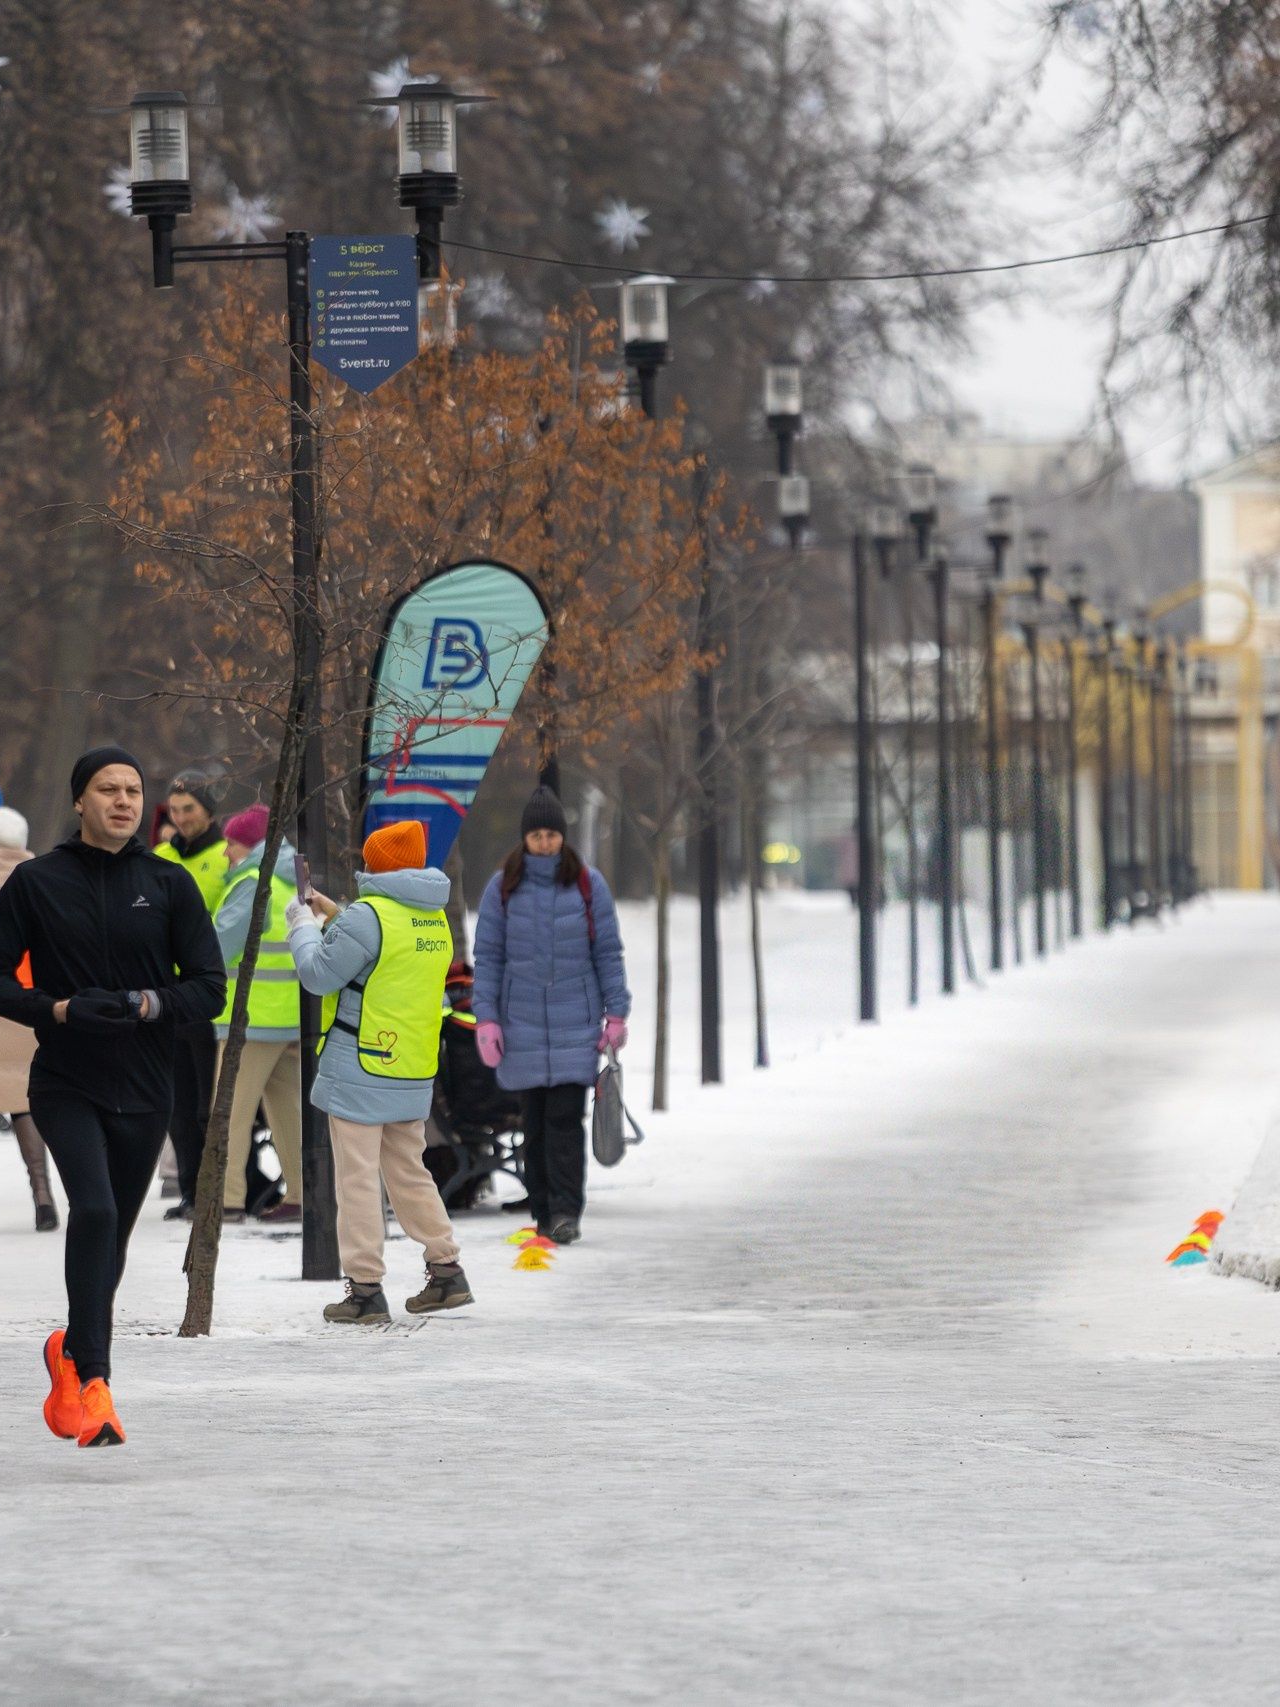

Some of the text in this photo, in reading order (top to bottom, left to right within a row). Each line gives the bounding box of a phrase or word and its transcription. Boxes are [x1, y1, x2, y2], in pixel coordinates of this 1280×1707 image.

[341, 243, 385, 255] 5 вёрст
[328, 270, 347, 278] парк
[358, 289, 380, 297] месте
[360, 301, 388, 309] субботу
[371, 325, 408, 333] атмосфера
[340, 358, 390, 368] 5verst.ru
